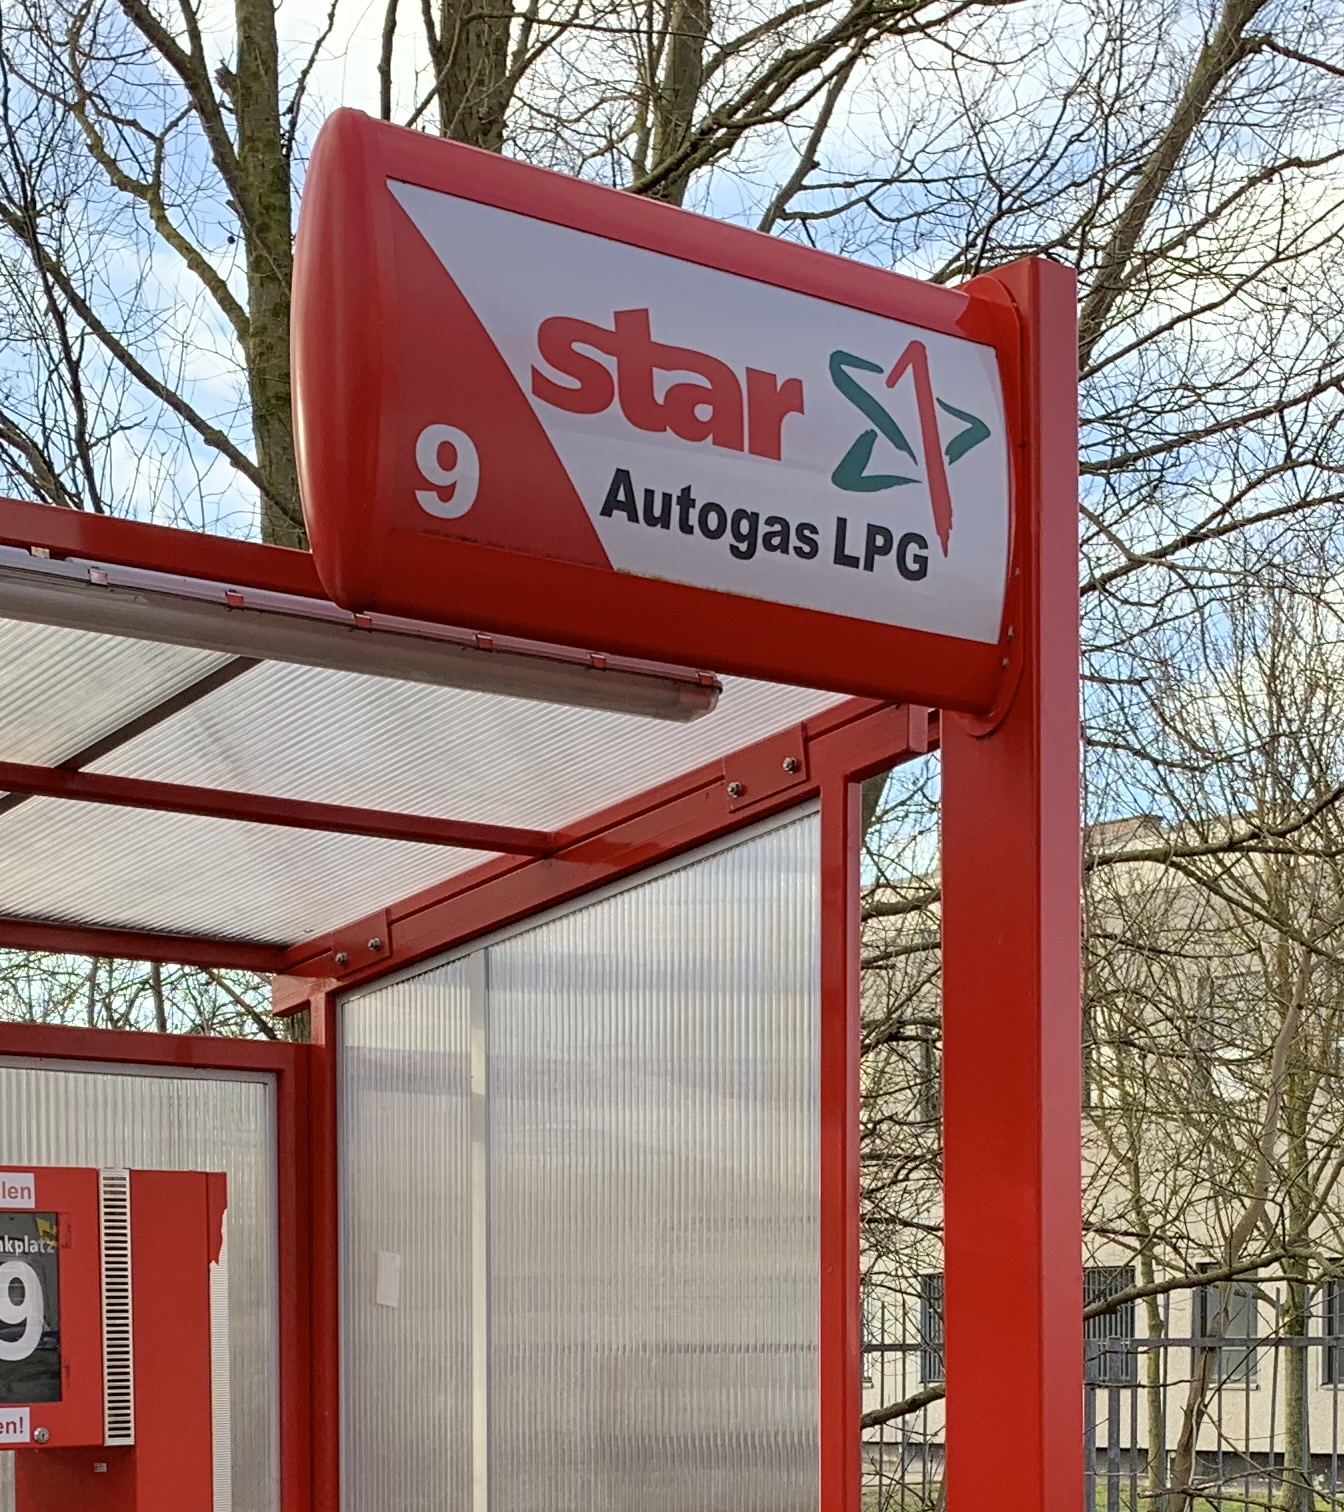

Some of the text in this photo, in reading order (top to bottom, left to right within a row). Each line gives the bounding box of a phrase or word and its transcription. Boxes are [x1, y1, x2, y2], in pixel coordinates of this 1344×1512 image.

[531, 308, 804, 462] star
[414, 423, 481, 520] 9
[599, 468, 930, 581] Autogas LPG
